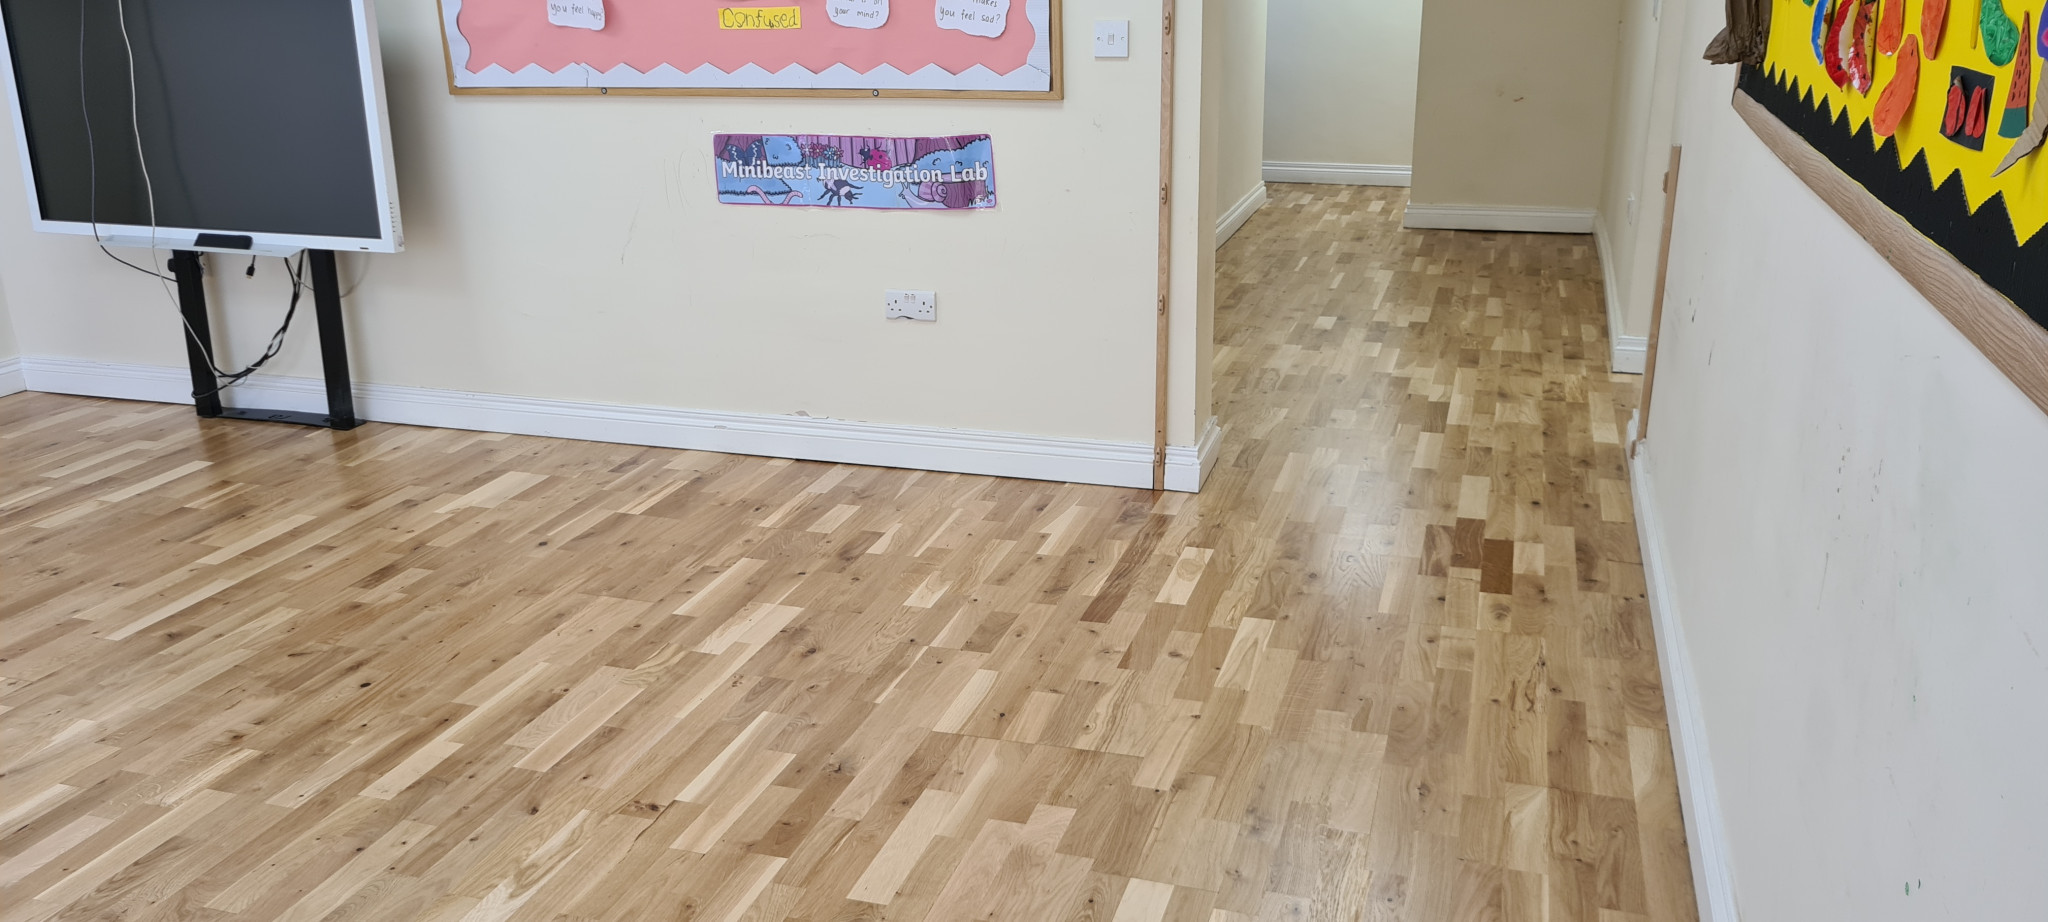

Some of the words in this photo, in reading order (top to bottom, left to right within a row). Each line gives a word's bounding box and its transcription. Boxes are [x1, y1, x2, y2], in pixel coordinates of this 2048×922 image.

[550, 3, 567, 16] you
[571, 3, 584, 15] feel
[722, 7, 798, 28] Confused
[833, 6, 850, 17] your
[856, 10, 879, 19] mind?
[940, 6, 955, 20] you
[961, 9, 975, 20] feel
[981, 13, 1001, 24] sad?
[721, 159, 812, 180] Minibeast
[818, 161, 944, 188] Investigation
[950, 160, 988, 183] Lab
